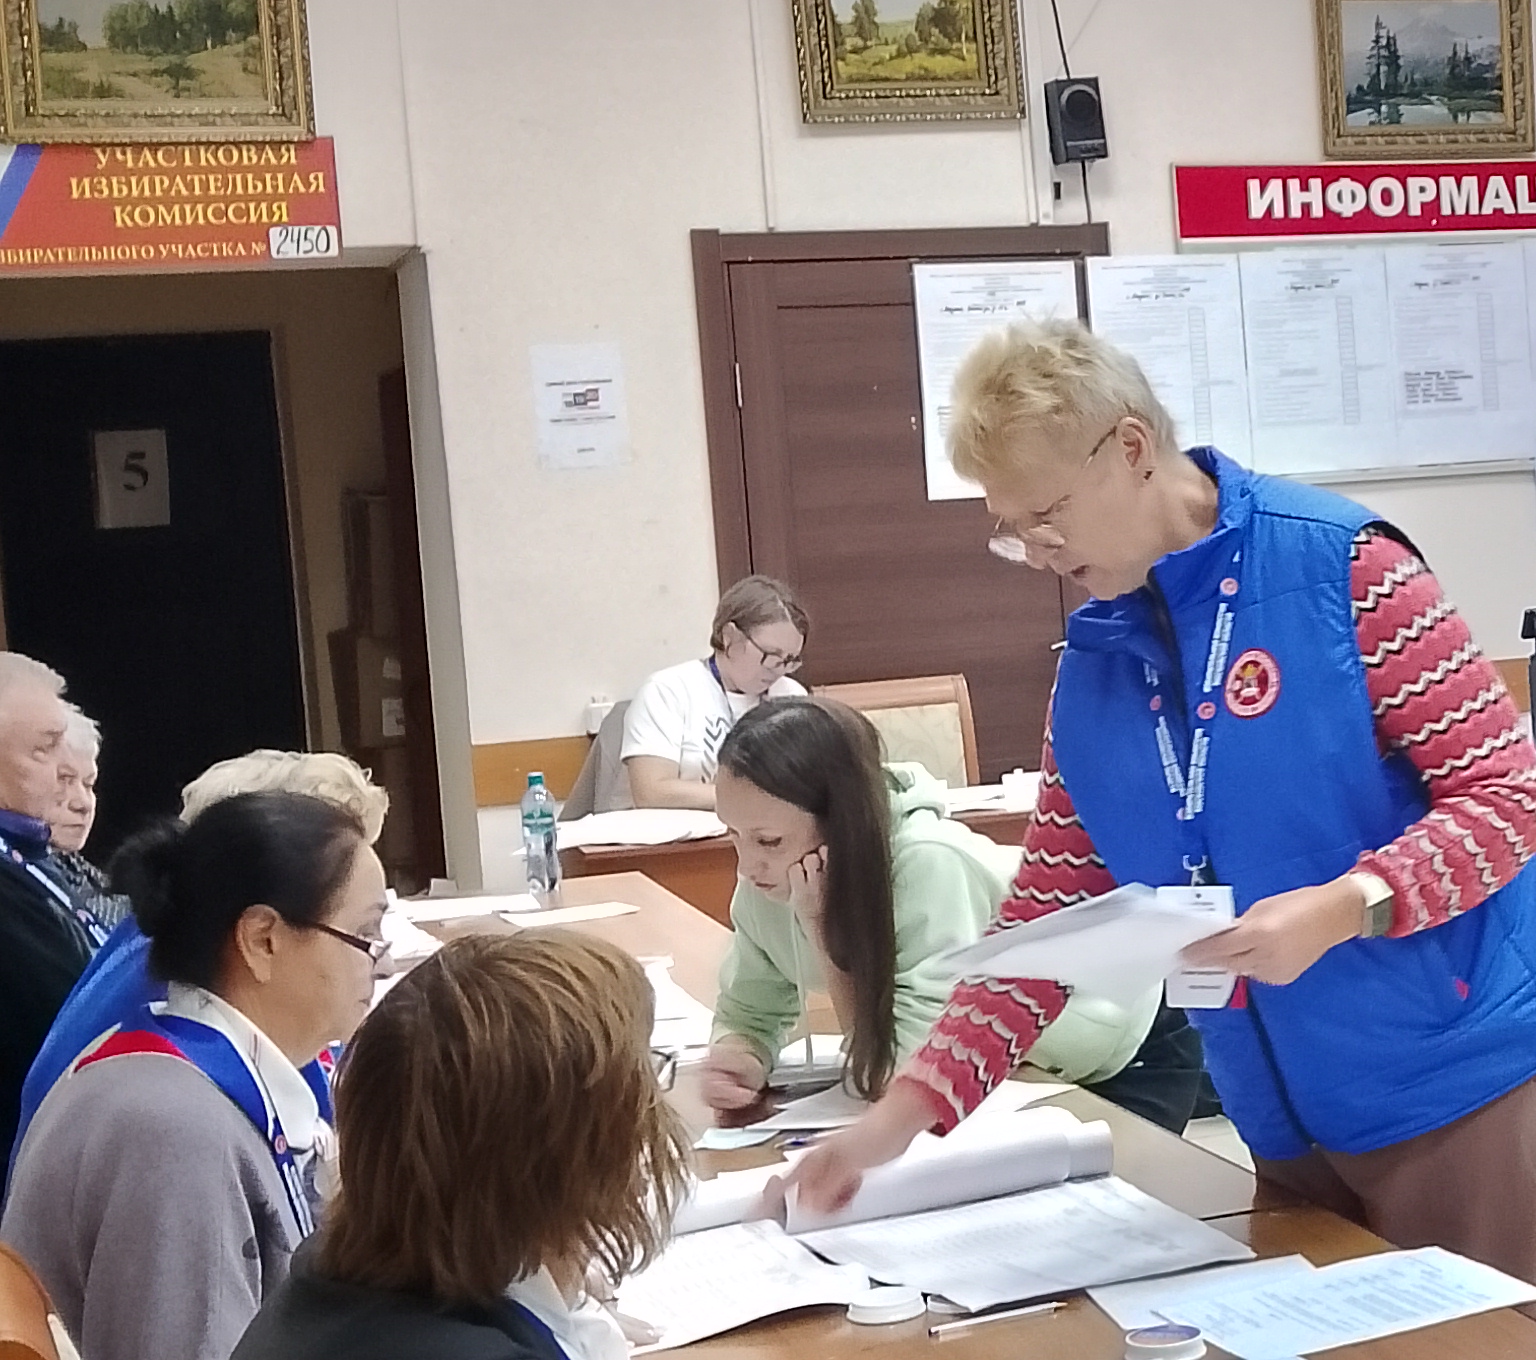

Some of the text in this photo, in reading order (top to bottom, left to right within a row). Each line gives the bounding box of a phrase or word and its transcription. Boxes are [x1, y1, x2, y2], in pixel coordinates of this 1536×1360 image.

[95, 142, 298, 169] УЧАСТКОВАЯ
[70, 171, 326, 200] ИЗБИРАТЕЛЬНАЯ
[113, 200, 290, 228] КОМИССИЯ
[158, 241, 248, 259] УЧАСТКА
[275, 226, 331, 256] 2450
[123, 450, 149, 492] 5
